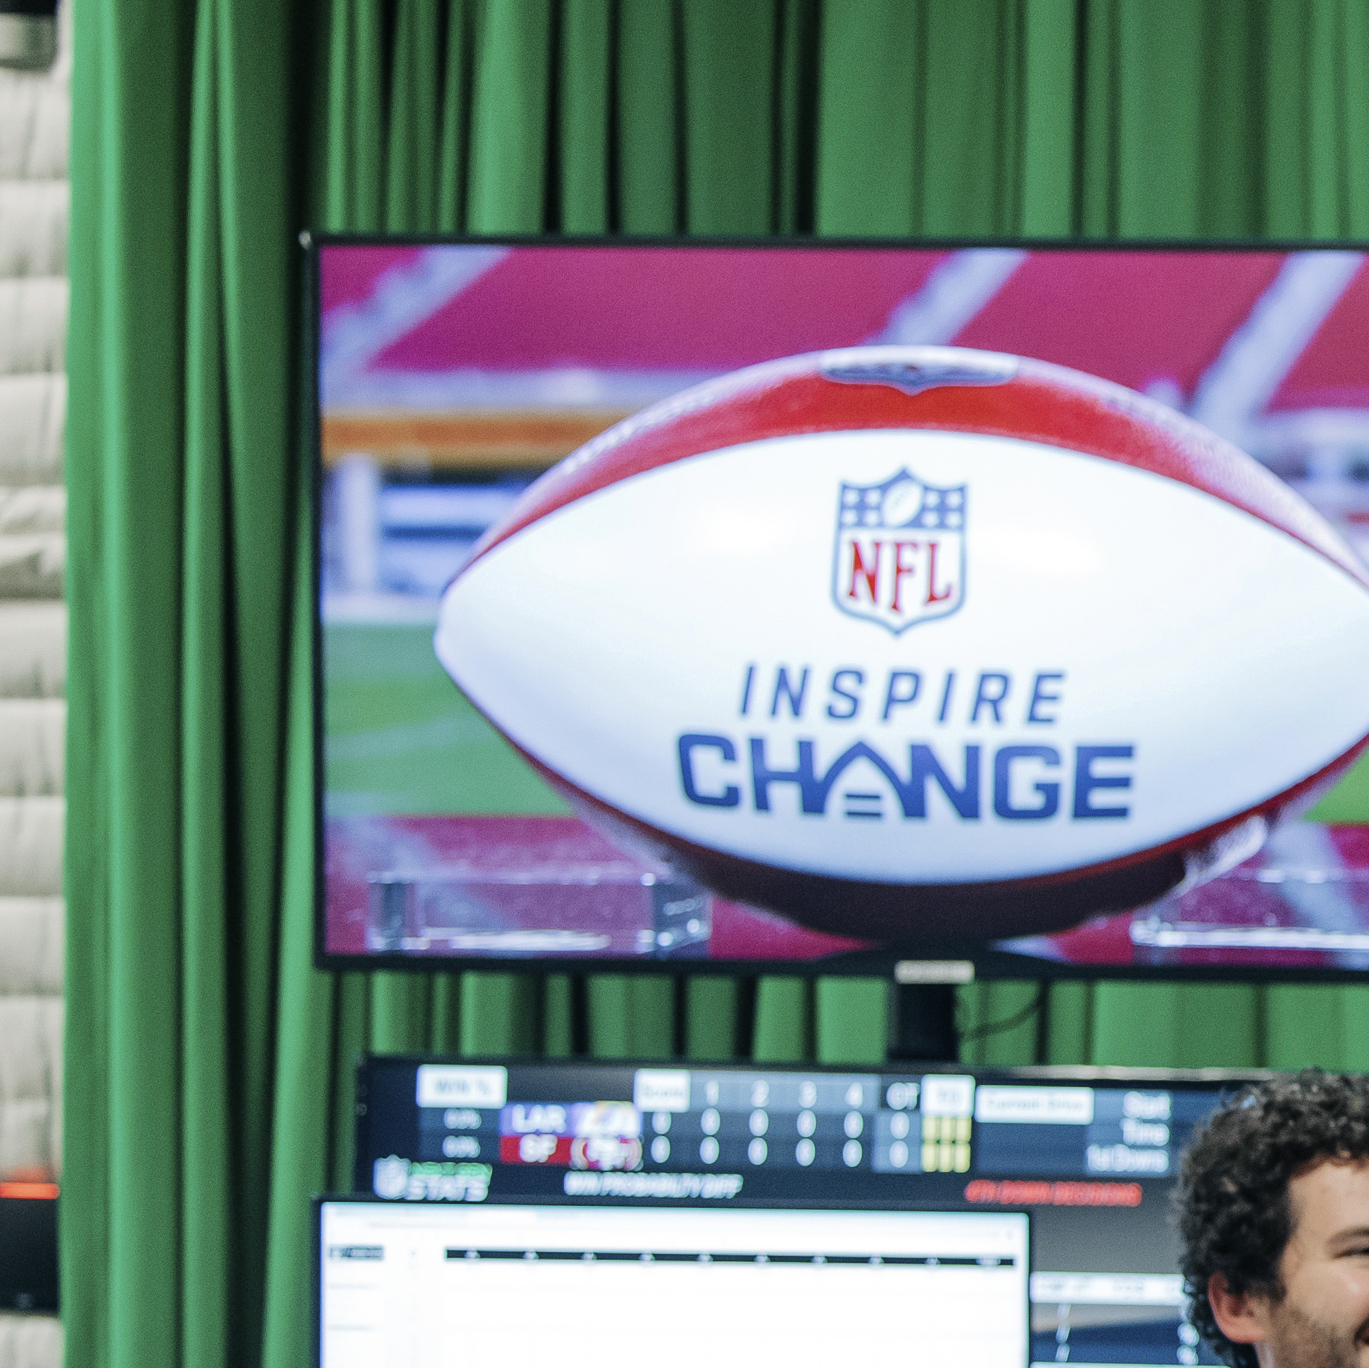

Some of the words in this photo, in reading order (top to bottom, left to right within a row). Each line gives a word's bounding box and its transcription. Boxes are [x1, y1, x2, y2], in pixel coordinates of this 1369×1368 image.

[847, 540, 952, 615] NFL
[739, 663, 1065, 729] INSPIRE
[677, 732, 1136, 820] CHANGE
